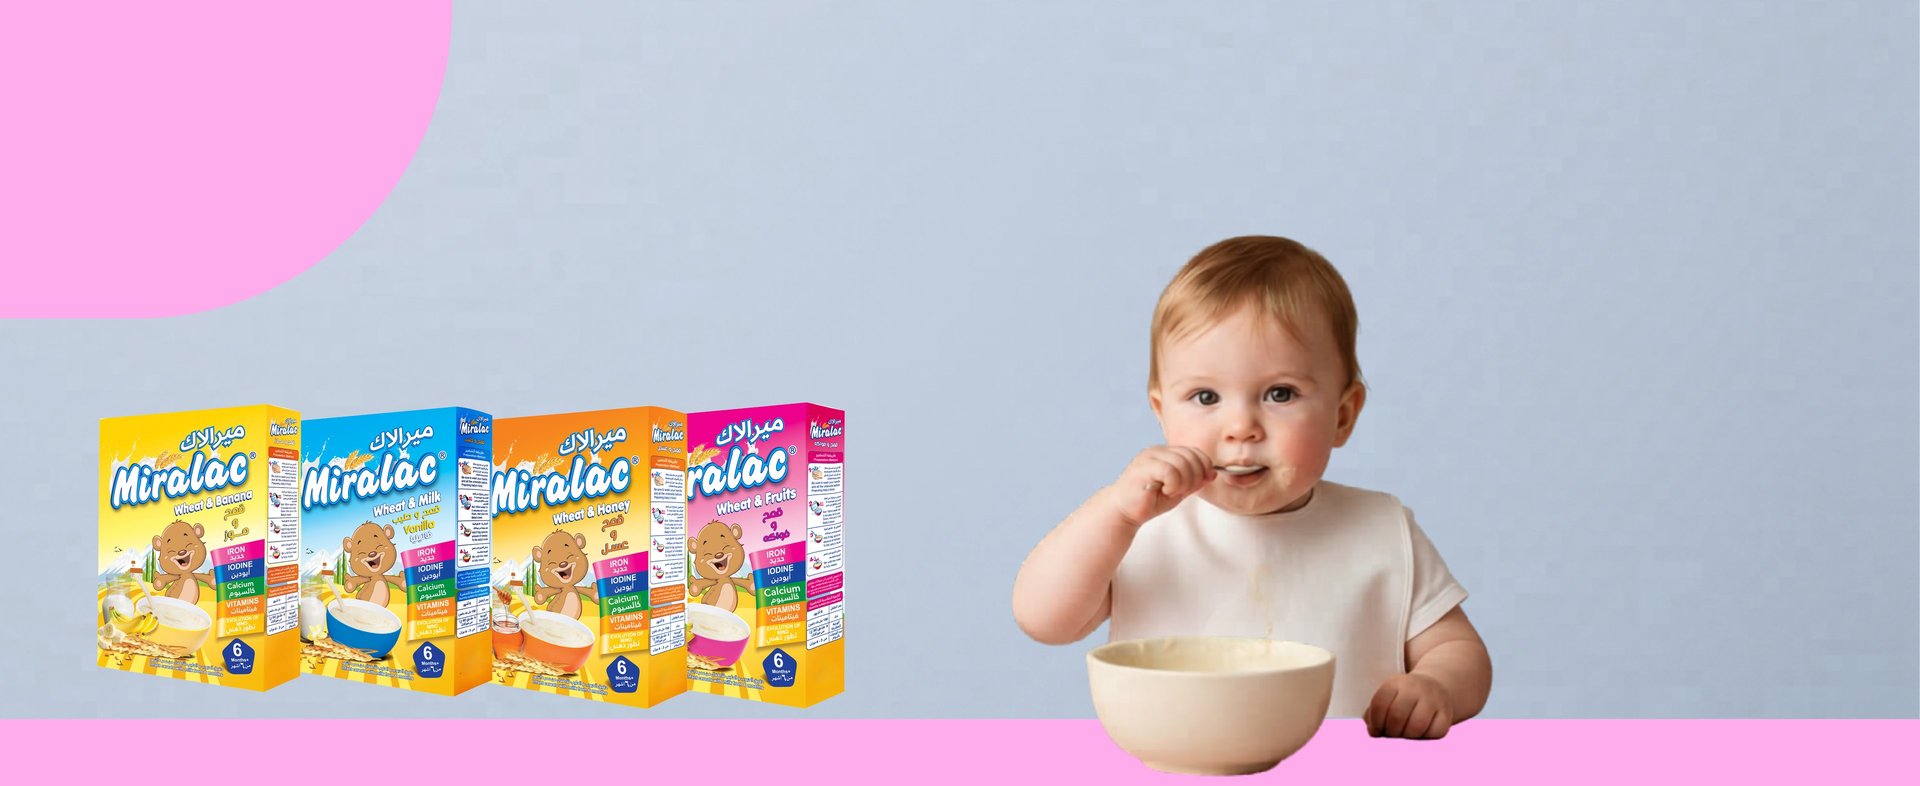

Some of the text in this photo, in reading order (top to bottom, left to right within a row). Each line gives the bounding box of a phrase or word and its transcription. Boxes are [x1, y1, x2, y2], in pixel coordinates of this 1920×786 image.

[460, 422, 490, 435] Miralac
[652, 427, 684, 443] Miralac
[715, 417, 784, 446] ميرالاك
[810, 425, 842, 440] Miralac
[180, 425, 246, 452] ميرالاك
[369, 425, 435, 452] ميرالاك
[558, 427, 628, 456] ميرالاك
[687, 445, 789, 501] ralac
[110, 450, 249, 511] Miralac
[301, 450, 440, 512] Miralac
[492, 454, 632, 518] Miralac
[174, 490, 253, 516] Wheat & Banana
[373, 490, 441, 517] Wheat & Milk
[716, 488, 797, 516] Wheat & Fruits
[224, 504, 246, 521] قمح
[422, 505, 441, 519] قمح
[552, 499, 631, 525] Wheat & Honey
[762, 507, 783, 523] قمح
[231, 518, 239, 529] و
[391, 513, 412, 525] حليب
[601, 513, 625, 532] قمح
[403, 519, 436, 535] Vanilla
[770, 521, 777, 531] و
[610, 530, 617, 541] و
[227, 545, 246, 556] IRON
[417, 547, 436, 557] IRON
[601, 540, 629, 556] عسل
[766, 548, 786, 558] IRON
[229, 553, 245, 562] حديد
[420, 555, 435, 563] حديد
[609, 557, 629, 568] IRON
[769, 556, 785, 564] حديد
[227, 560, 253, 571] IODINE
[417, 562, 444, 573] IODINE
[612, 566, 628, 574] حديد
[767, 564, 794, 575] IODINE
[610, 573, 637, 584] IODINE
[227, 581, 254, 590] Calcium
[417, 583, 445, 592] Calcium
[764, 585, 801, 597] Calcium
[228, 588, 256, 599] كالسيوم
[419, 589, 447, 602] كالسيوم
[608, 594, 639, 605] Calcium
[771, 593, 800, 606] كالسيوم
[225, 597, 259, 608] VITAMINS
[416, 599, 450, 611] VITAMINS
[611, 600, 642, 615] كالسيوم
[766, 604, 801, 615] VITAMINS
[609, 612, 644, 624] VITAMINS
[232, 642, 242, 657] 6
[423, 645, 433, 660] 6
[773, 652, 784, 668] 6
[617, 660, 627, 675] 6
